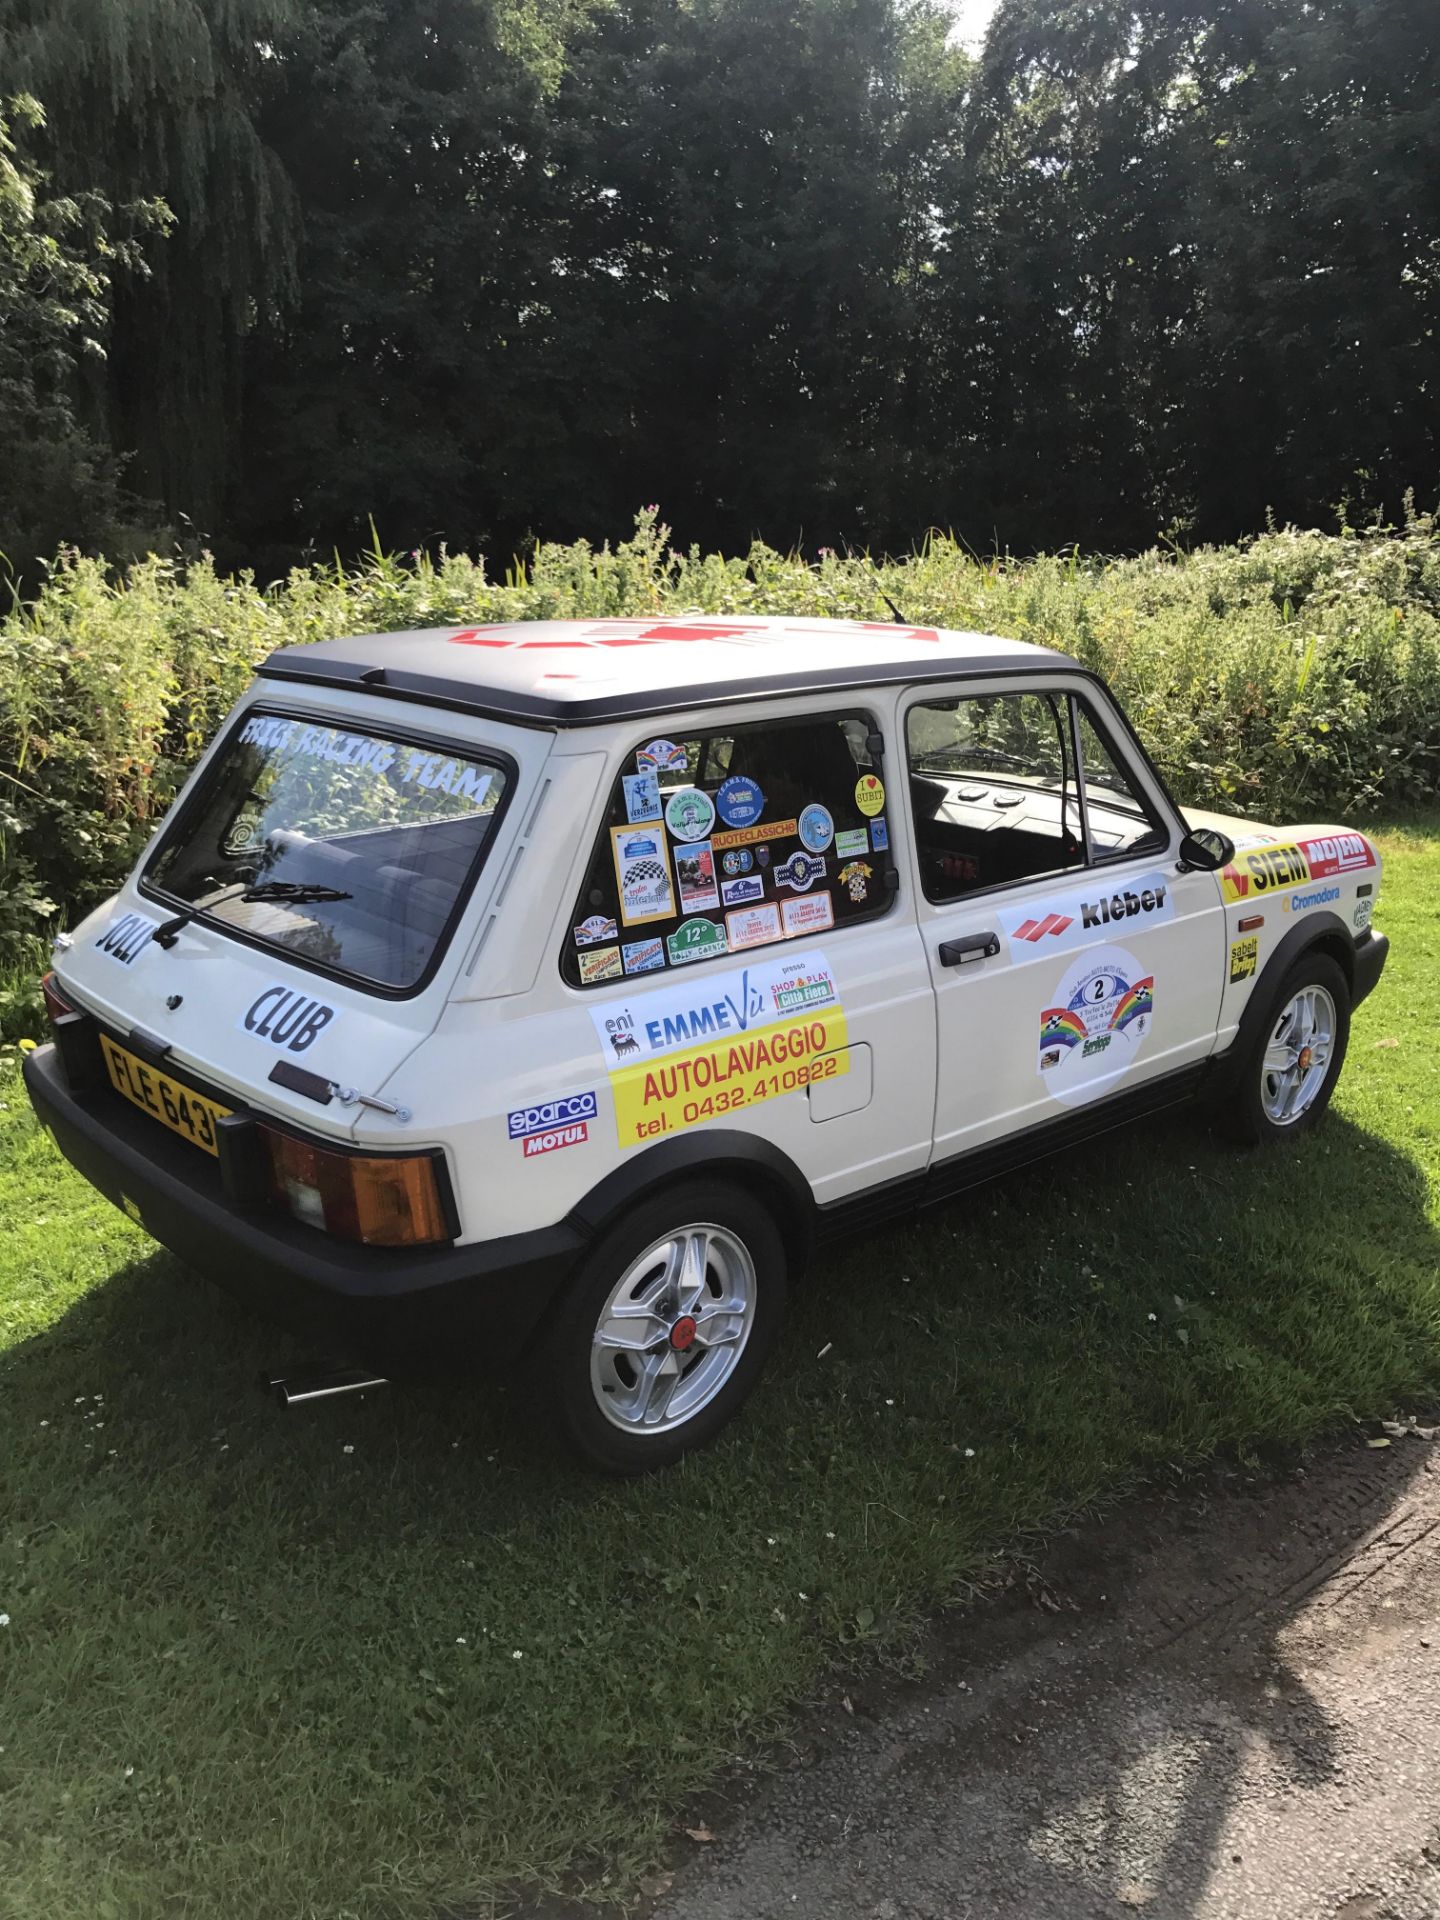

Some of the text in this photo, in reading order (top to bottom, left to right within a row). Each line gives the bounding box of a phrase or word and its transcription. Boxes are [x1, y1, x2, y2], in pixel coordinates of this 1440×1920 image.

[294, 726, 396, 773] RACING
[402, 752, 493, 805] TEAM
[857, 790, 883, 804] SUBIT
[860, 780, 865, 791] I
[1306, 834, 1367, 867] NOLAN
[1247, 847, 1308, 890] SIEM
[1292, 887, 1340, 911] Cromodora
[95, 914, 158, 964] JOLLY
[686, 925, 707, 943] 12°
[626, 941, 662, 967] VERIFICATO
[671, 942, 726, 961] RALLY CARNIA
[1231, 937, 1257, 959] sabelt
[583, 950, 619, 976] VERIFICATO
[782, 963, 806, 975] presso
[771, 980, 795, 994] SHOP
[806, 971, 829, 984] PLAY
[804, 984, 827, 1000] Fiera
[1094, 979, 1104, 1000] 2
[244, 986, 334, 1052] CLUB
[605, 1008, 635, 1034] eni
[643, 1022, 827, 1106] AUTOLAVAGGIO
[109, 1047, 230, 1147] FLE 643
[636, 1057, 837, 1138] tel. 0432.410822
[510, 1094, 594, 1133] sparco
[527, 1126, 586, 1155] MOTUL
